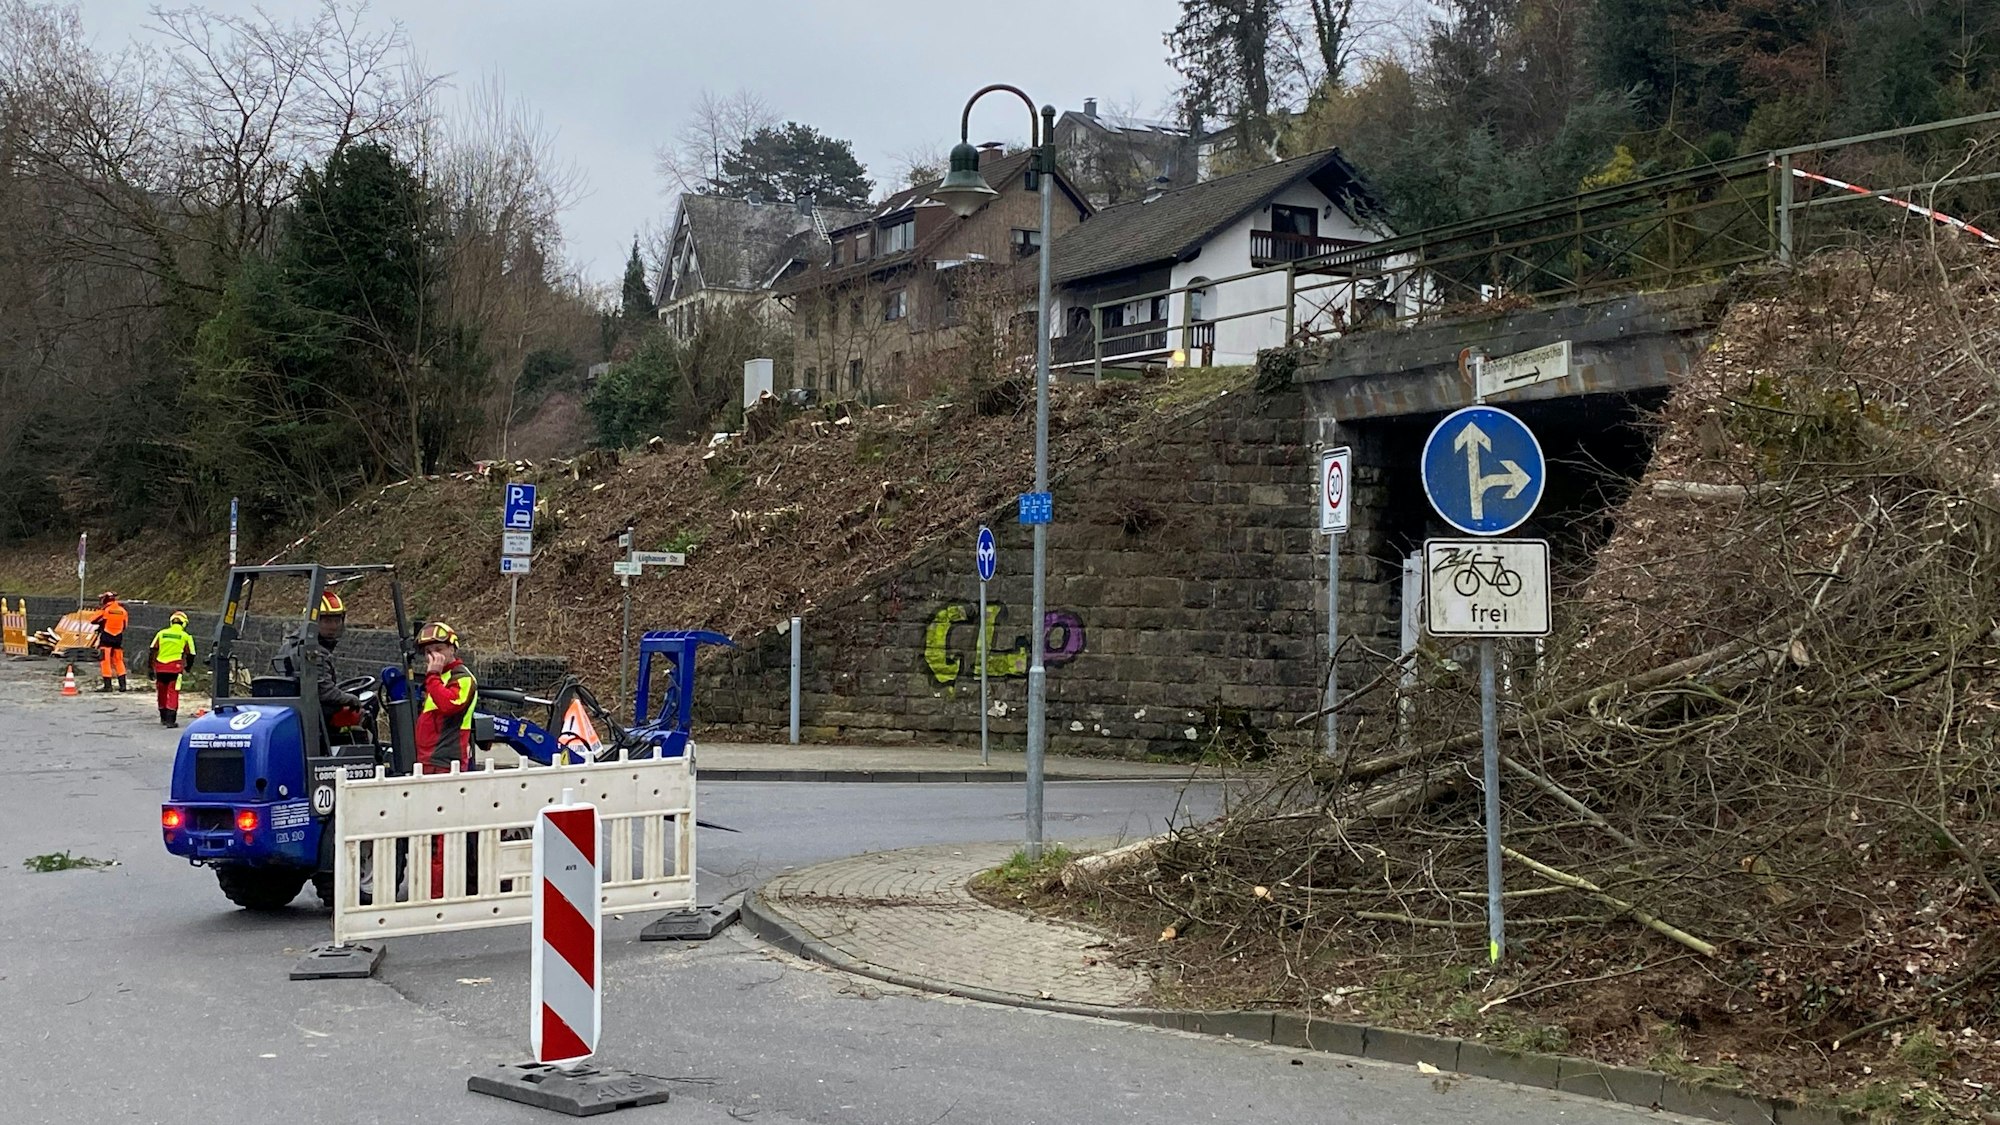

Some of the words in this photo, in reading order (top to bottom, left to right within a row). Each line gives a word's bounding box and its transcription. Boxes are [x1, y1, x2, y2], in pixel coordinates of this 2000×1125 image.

[1331, 473, 1340, 496] 30
[510, 486, 524, 505] P
[1328, 511, 1341, 524] ZONE
[1471, 603, 1507, 623] frei
[233, 713, 257, 725] 20
[318, 789, 331, 808] 20
[597, 1080, 646, 1102] AVS
